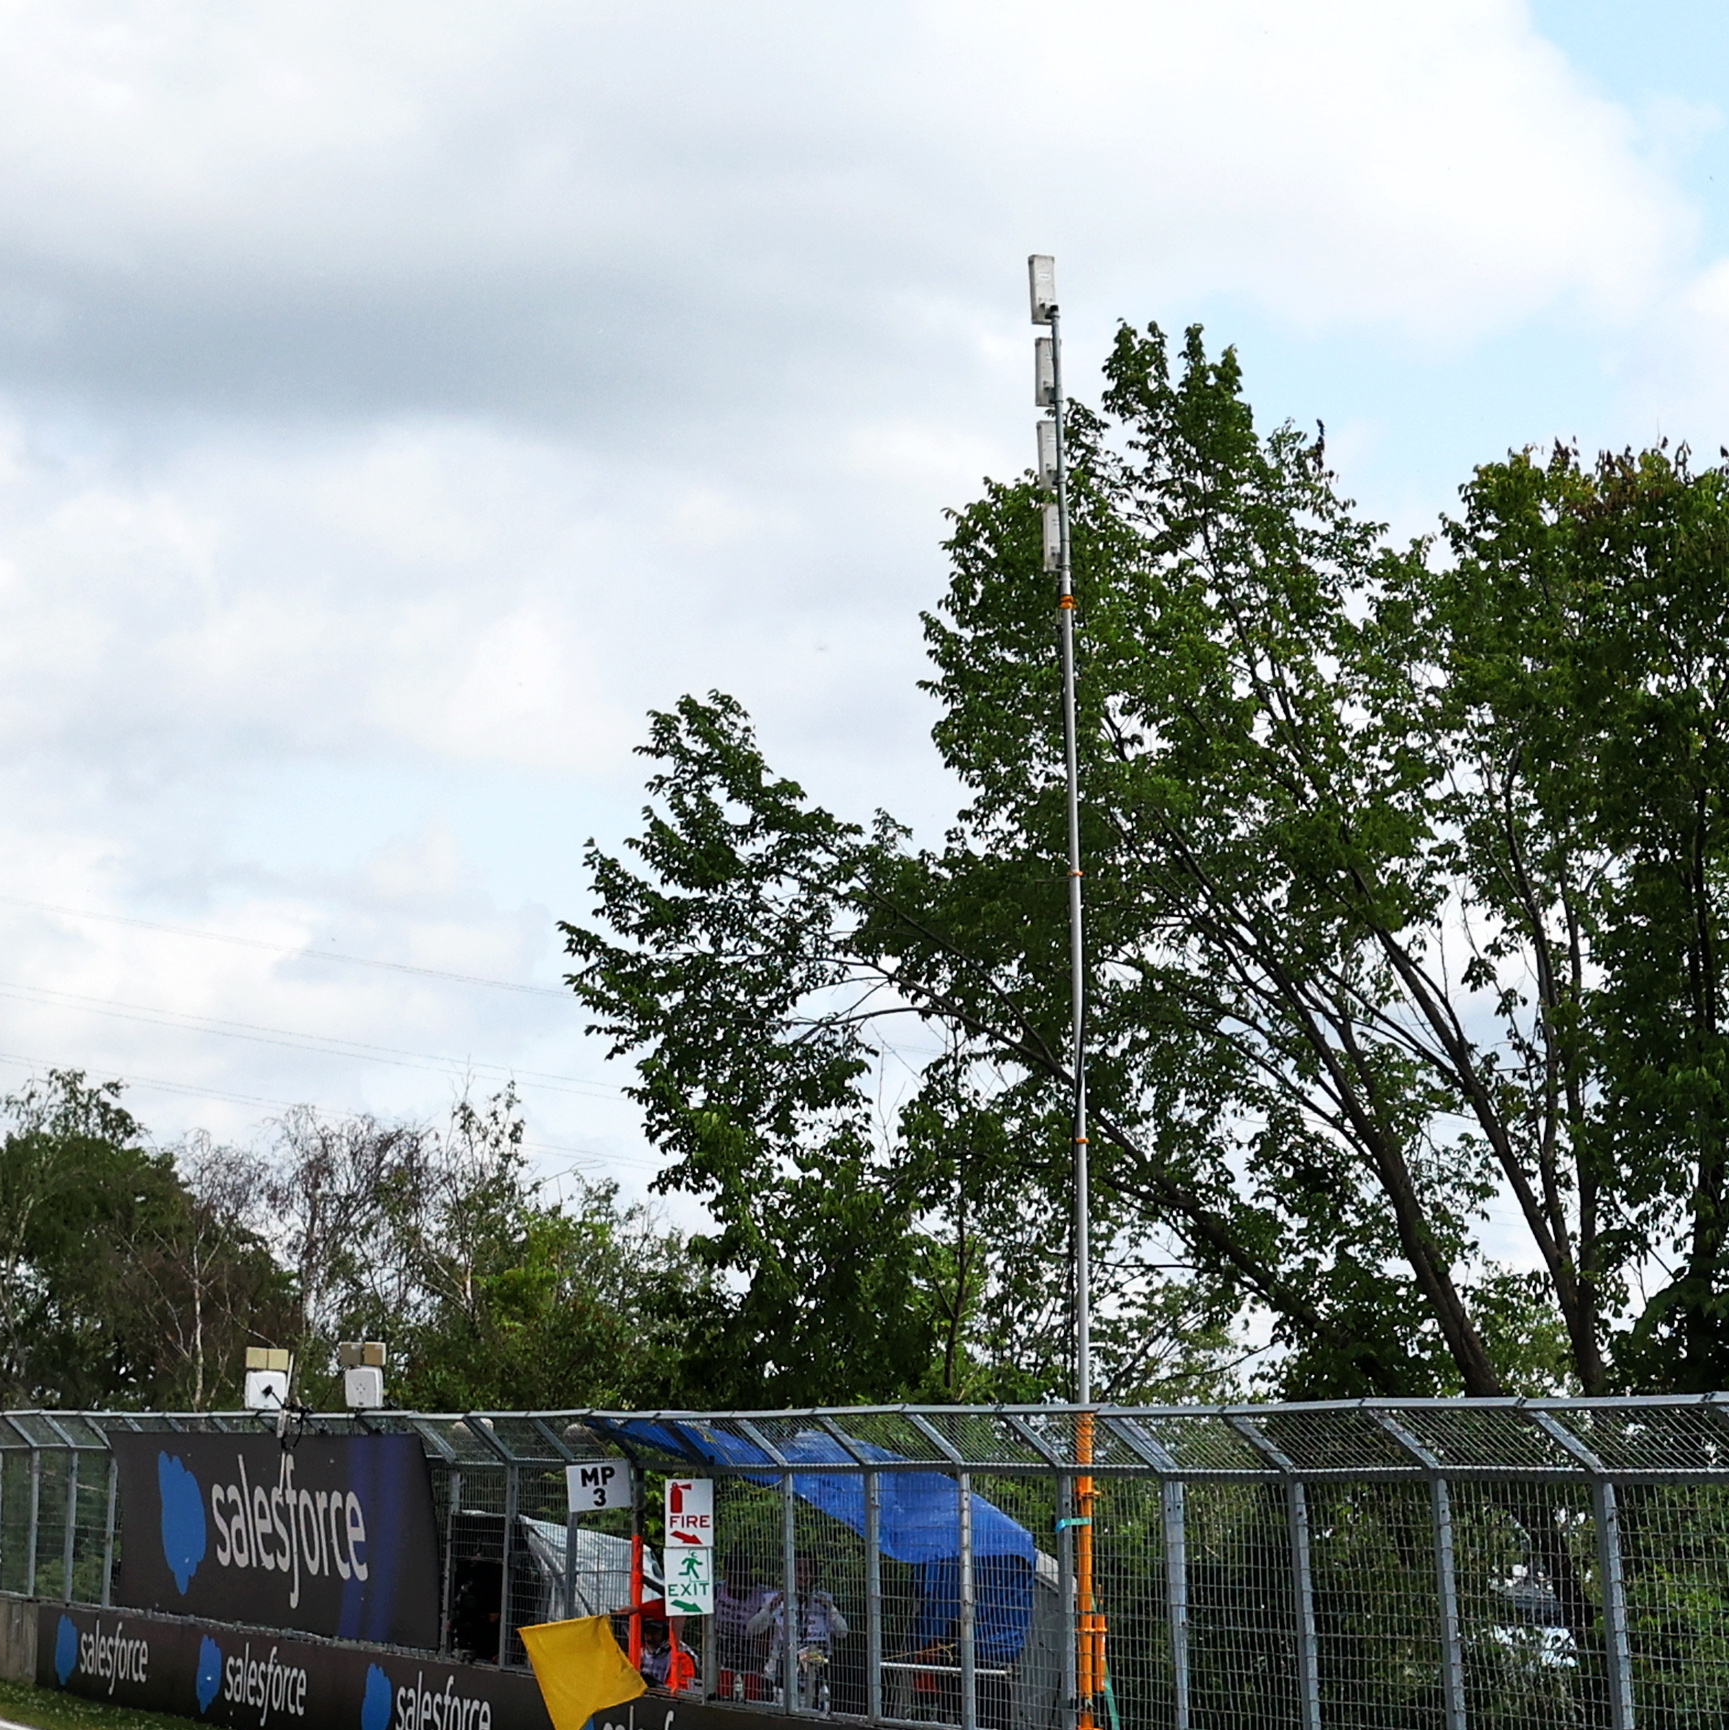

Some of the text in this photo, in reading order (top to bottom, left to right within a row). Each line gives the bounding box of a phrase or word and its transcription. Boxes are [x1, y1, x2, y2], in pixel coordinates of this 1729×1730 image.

[580, 1466, 615, 1487] MP
[593, 1488, 606, 1507] 3
[211, 1452, 368, 1609] salesforce
[670, 1515, 710, 1528] FIRE
[668, 1583, 709, 1597] EXIT
[80, 1620, 149, 1695] salesforce
[224, 1643, 307, 1727] salesforce
